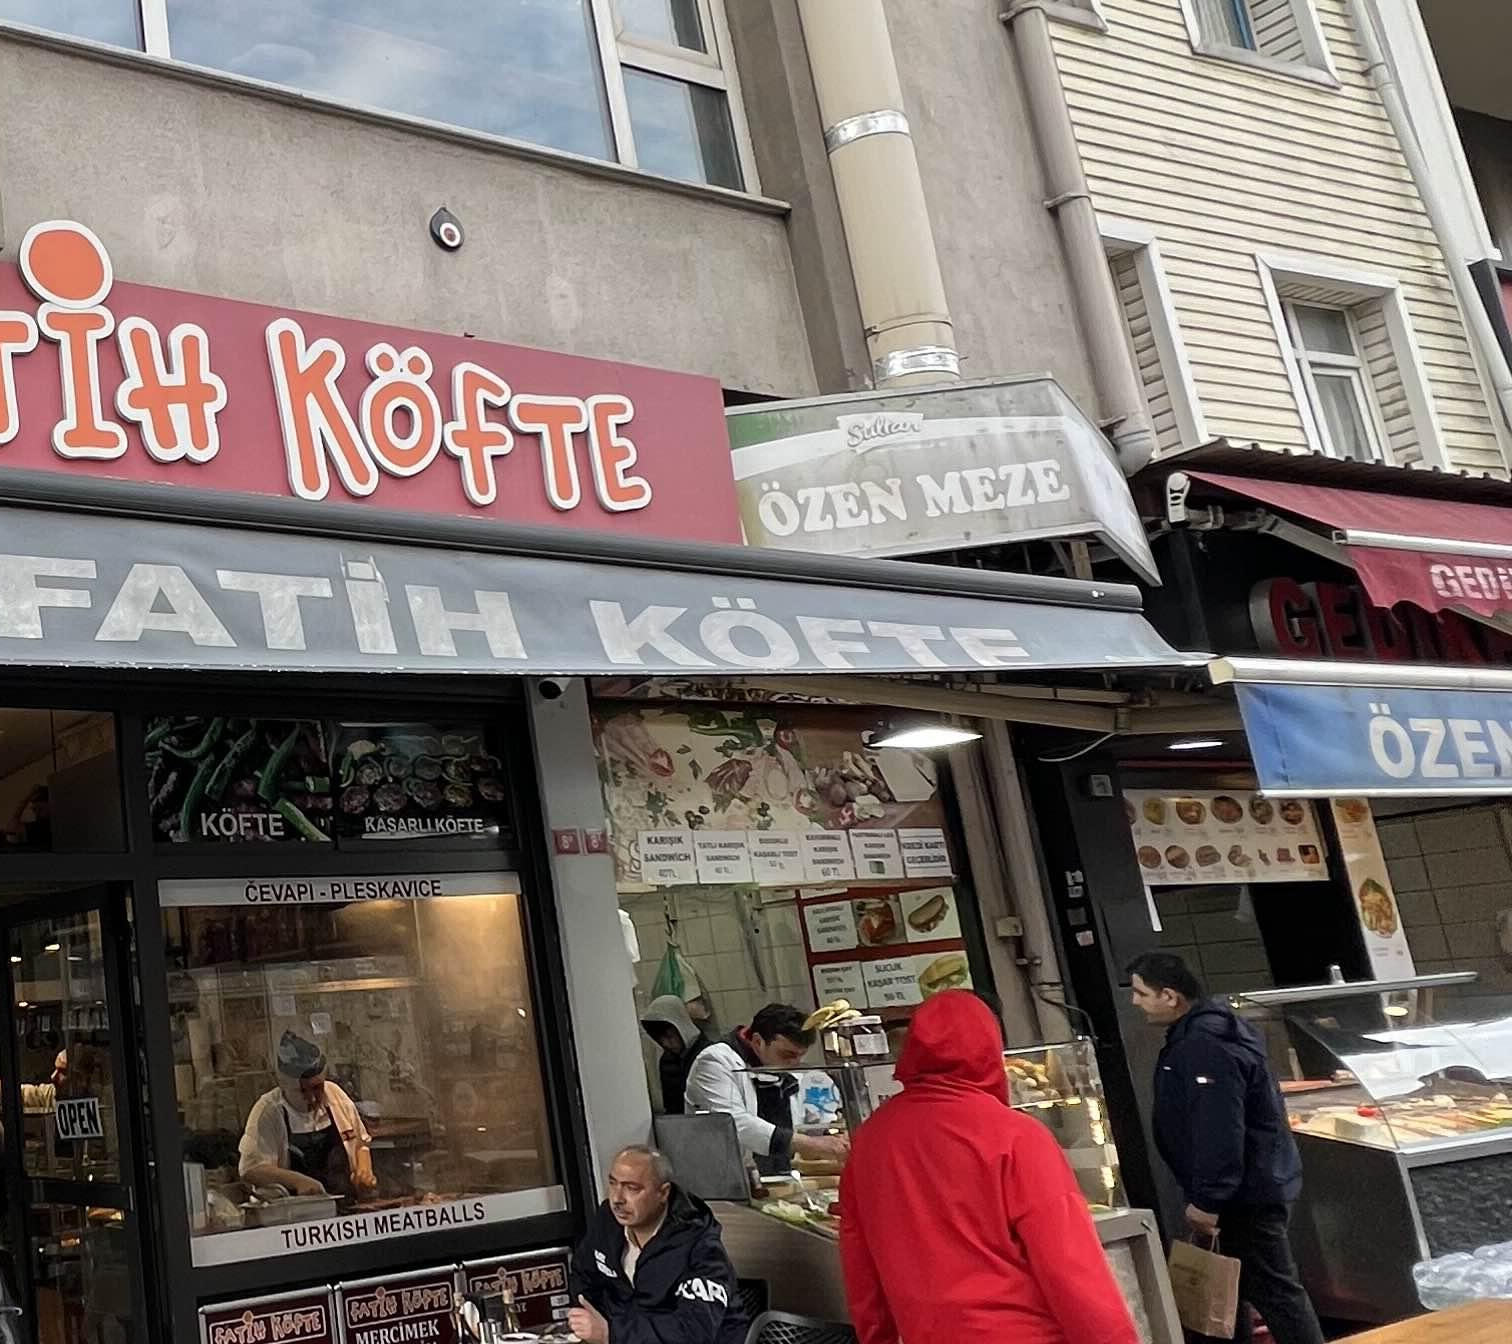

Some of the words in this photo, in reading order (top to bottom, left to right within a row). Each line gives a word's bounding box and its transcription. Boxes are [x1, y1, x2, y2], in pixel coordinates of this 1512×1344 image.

[265, 317, 652, 513] KÖFTE
[758, 477, 908, 537] ÖZEN
[916, 459, 1070, 517] MEZE
[1430, 565, 1512, 600] GEDİ
[589, 596, 1031, 669] KÖFTE
[200, 808, 285, 838] KÖFTE
[245, 880, 314, 903] ČEVAPI
[331, 879, 442, 900] PLESKAVICE
[57, 1102, 101, 1136] OPEN
[280, 1219, 369, 1250] TURKISH
[374, 1202, 485, 1235] MEATBALLS
[270, 1311, 322, 1341] KÖFTE
